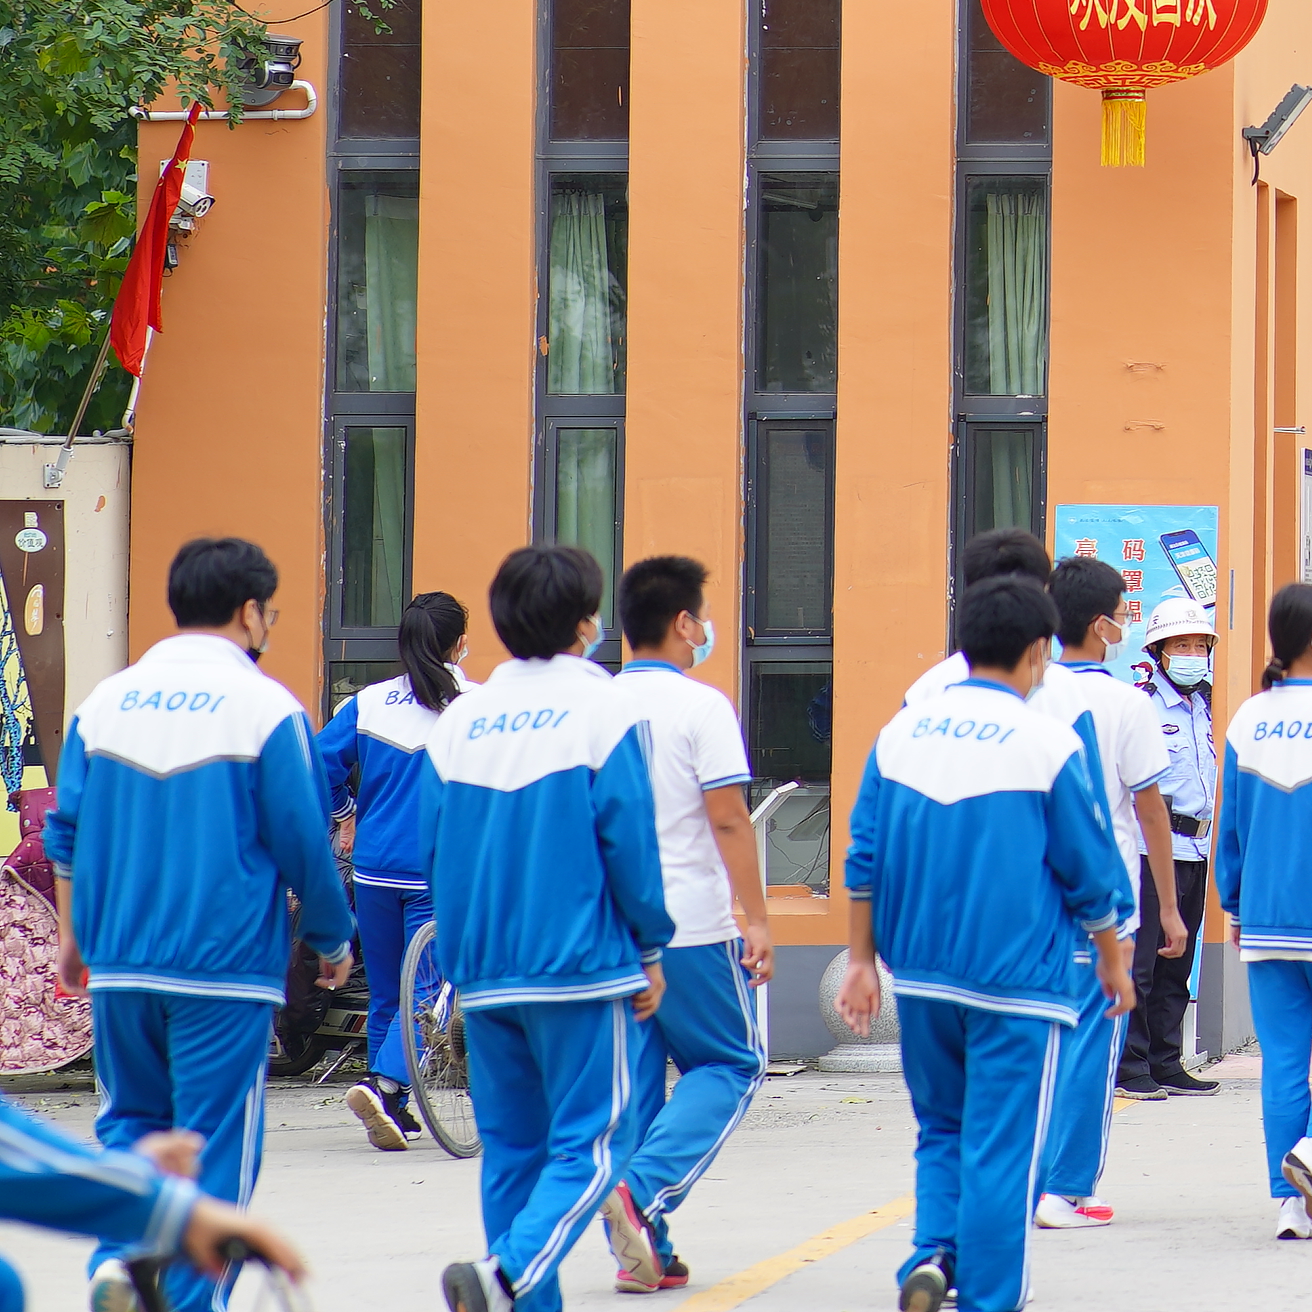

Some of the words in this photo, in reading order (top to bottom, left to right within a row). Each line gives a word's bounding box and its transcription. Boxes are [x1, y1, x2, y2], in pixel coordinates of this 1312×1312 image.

[120, 690, 225, 713] BAODI
[469, 709, 569, 740] BAODI
[912, 717, 1015, 744] BAODI
